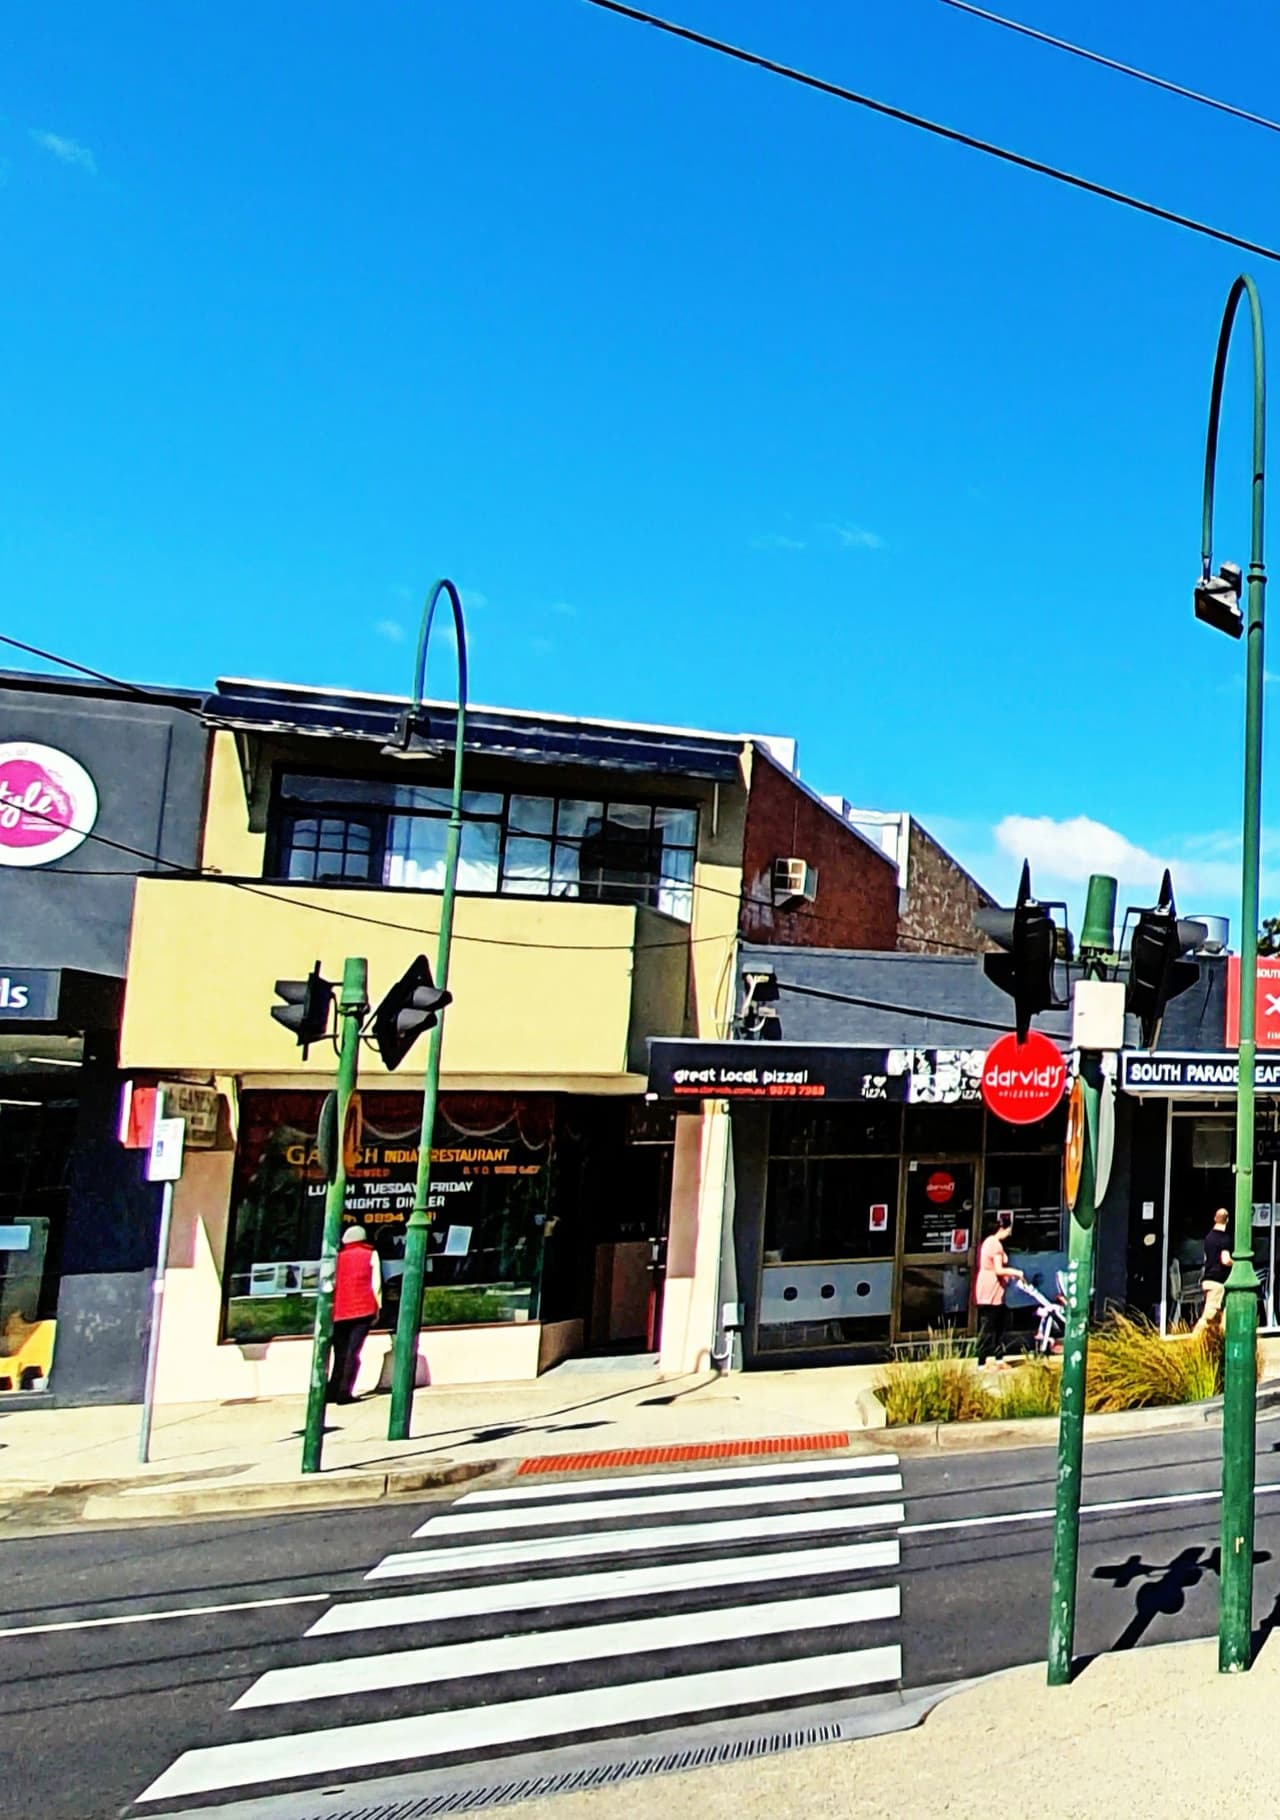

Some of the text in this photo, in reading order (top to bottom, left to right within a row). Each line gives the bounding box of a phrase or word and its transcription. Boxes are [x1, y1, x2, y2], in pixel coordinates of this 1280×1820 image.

[674, 1069, 715, 1084] great
[985, 1064, 1062, 1089] darvid's
[1131, 1063, 1181, 1082] SOUTH
[1187, 1064, 1239, 1082] PARADE
[384, 1149, 418, 1163] INDIA
[430, 1148, 510, 1162] RESTAURANT
[308, 1182, 473, 1196] LUH TUESDAY FRIDAY
